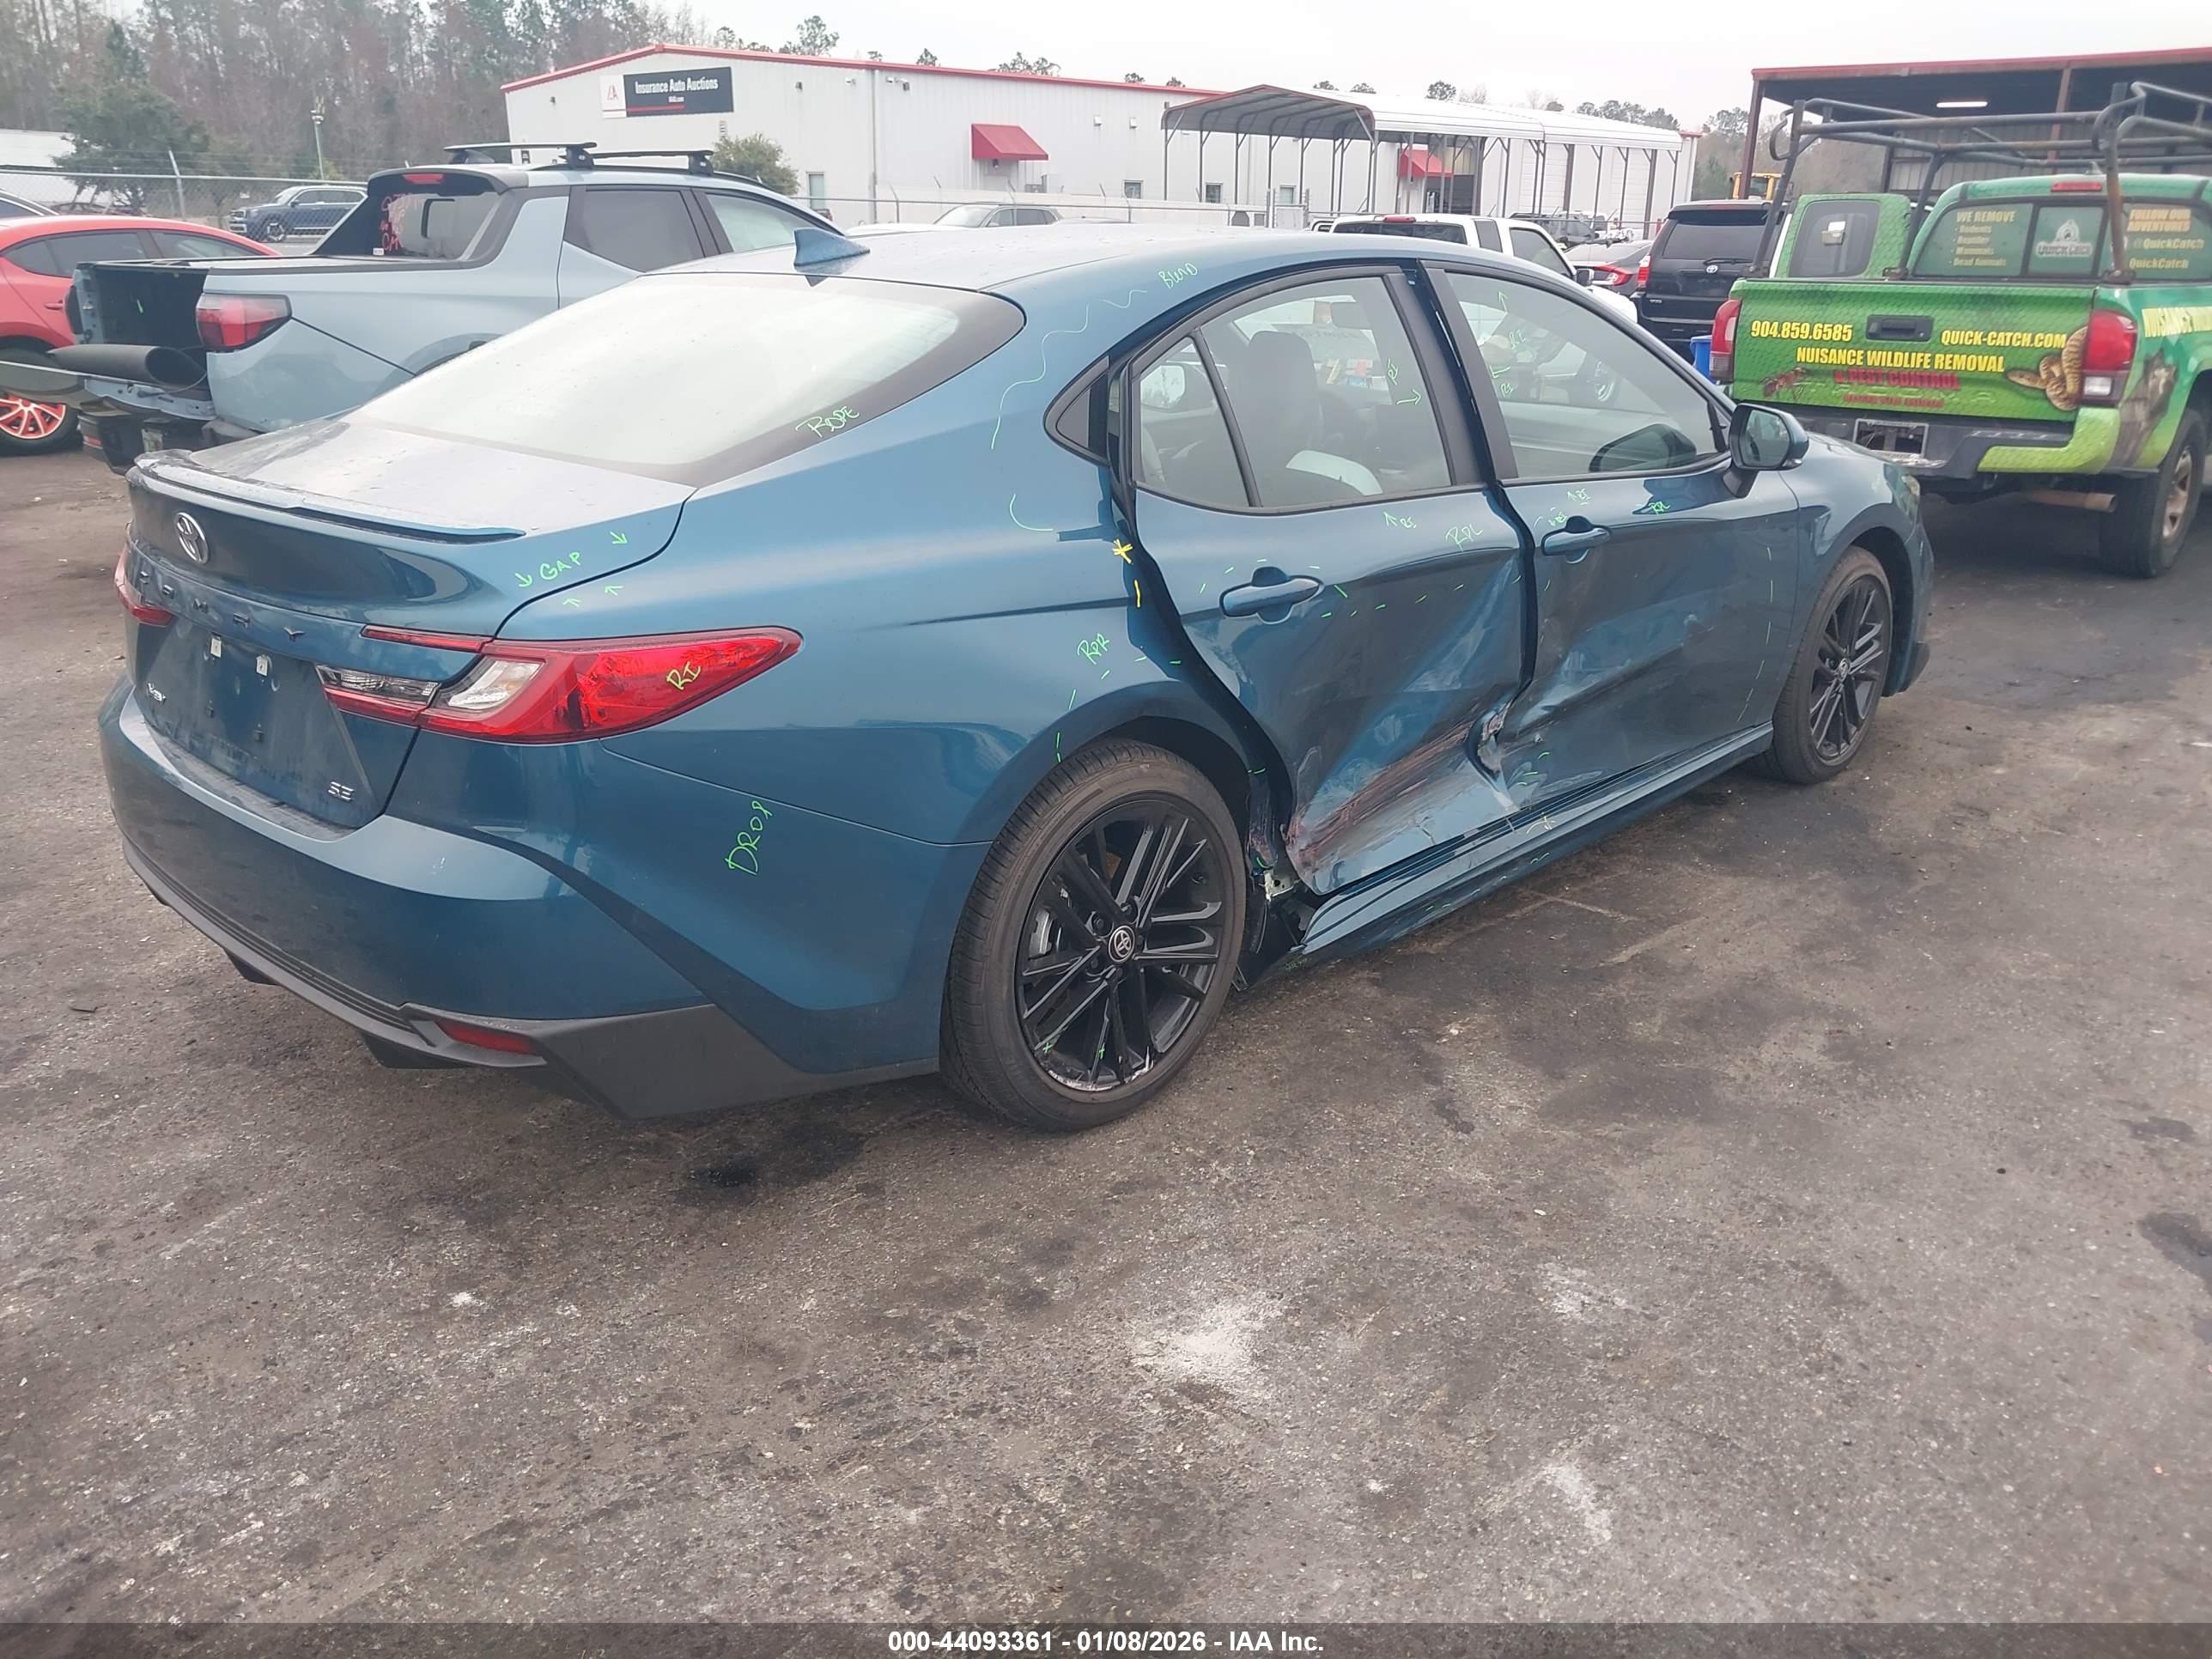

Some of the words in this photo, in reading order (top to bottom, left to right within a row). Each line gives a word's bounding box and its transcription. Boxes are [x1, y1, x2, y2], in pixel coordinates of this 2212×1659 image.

[635, 81, 668, 94] Insurance
[669, 78, 685, 91] Auto
[687, 76, 718, 90] Auctions
[1957, 211, 1973, 222] WE
[1974, 210, 2016, 222] REMOVE
[2127, 220, 2190, 232] ADVENTURES
[2130, 258, 2189, 269] QuickCatch
[1751, 320, 1853, 342] 904.859.6585
[1942, 330, 2067, 349] QUICK-CATCH.COM
[1796, 347, 1864, 366] NUISANCE
[1867, 350, 1931, 369] WILDLIFE
[1934, 353, 2004, 373] REMOVAL
[1847, 368, 1884, 385] PEST
[1887, 371, 1960, 390] CONTROL
[539, 551, 581, 580] GAP
[666, 661, 701, 690] RI
[328, 781, 354, 801] SE
